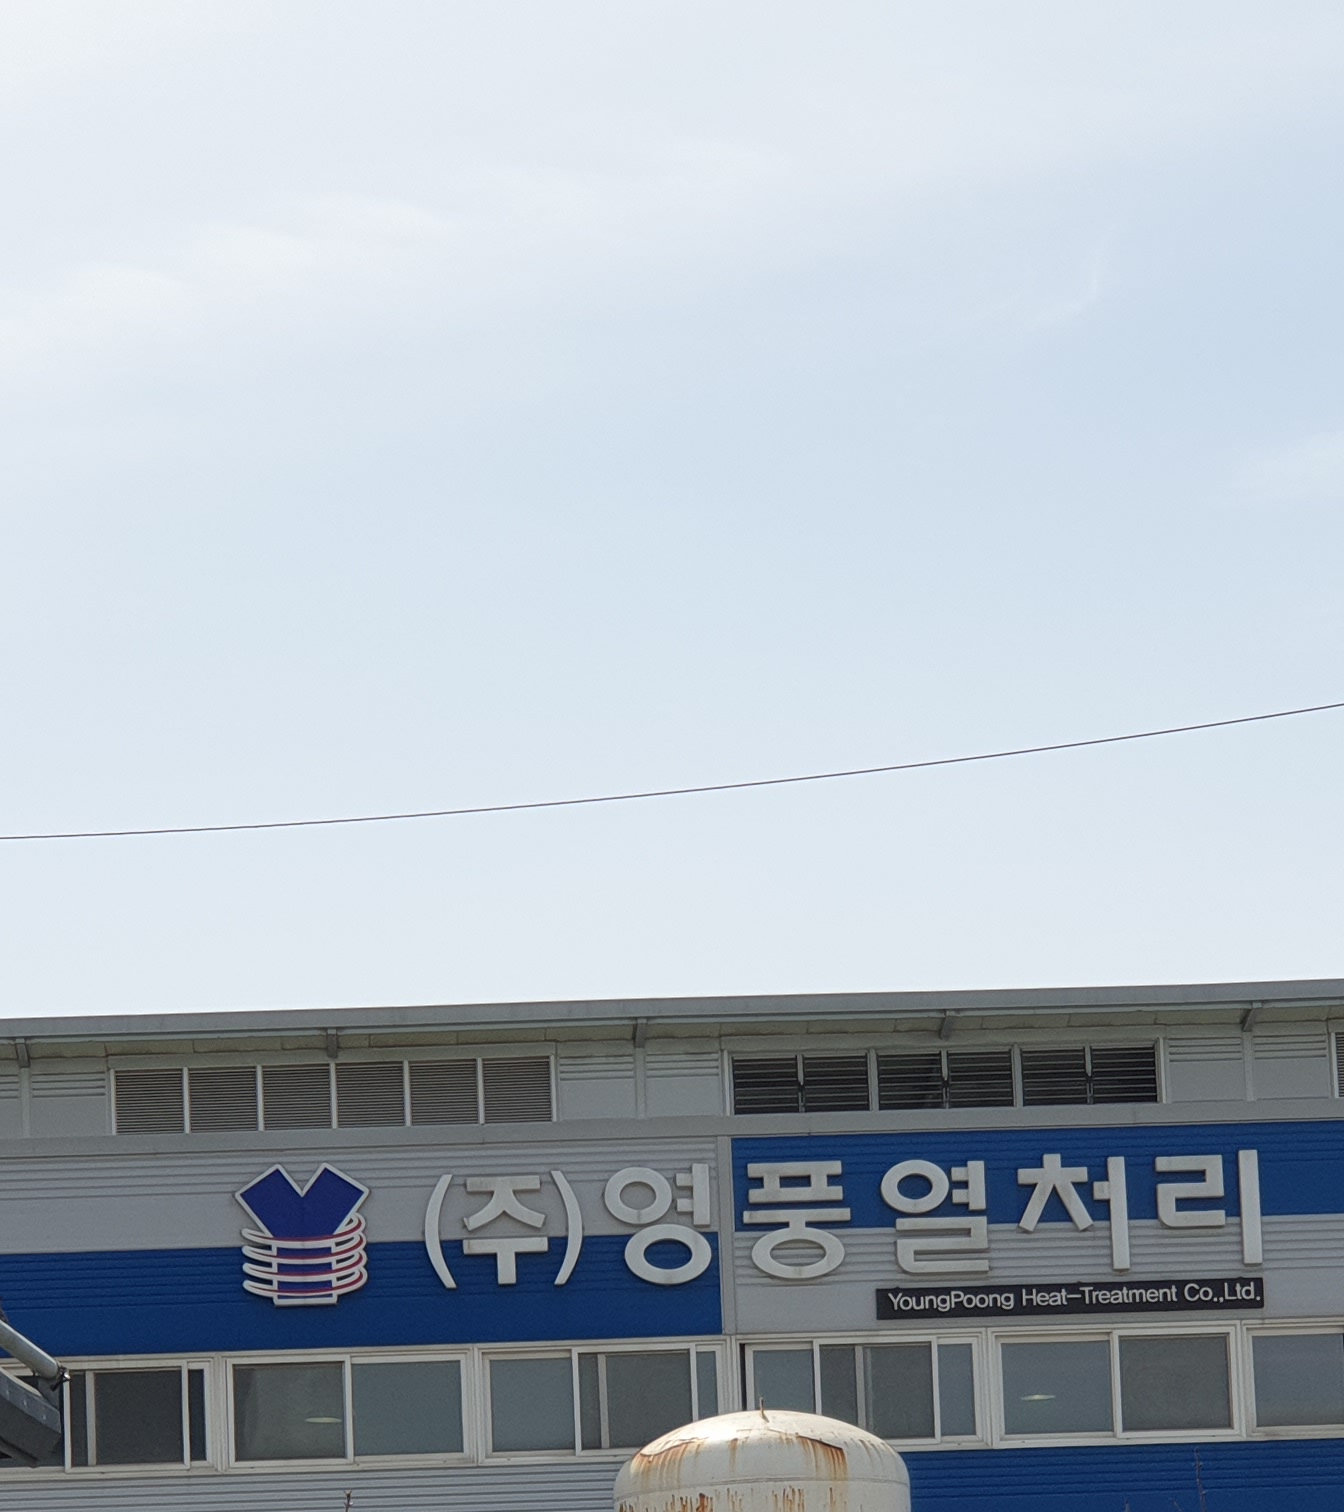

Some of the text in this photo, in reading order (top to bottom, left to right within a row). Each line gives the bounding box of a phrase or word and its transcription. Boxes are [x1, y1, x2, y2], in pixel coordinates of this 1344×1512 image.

[424, 1149, 1262, 1288] (주)영풍열처리
[888, 1282, 1261, 1312] YoungPoong Heat-Treatment Co.,Ltd.
